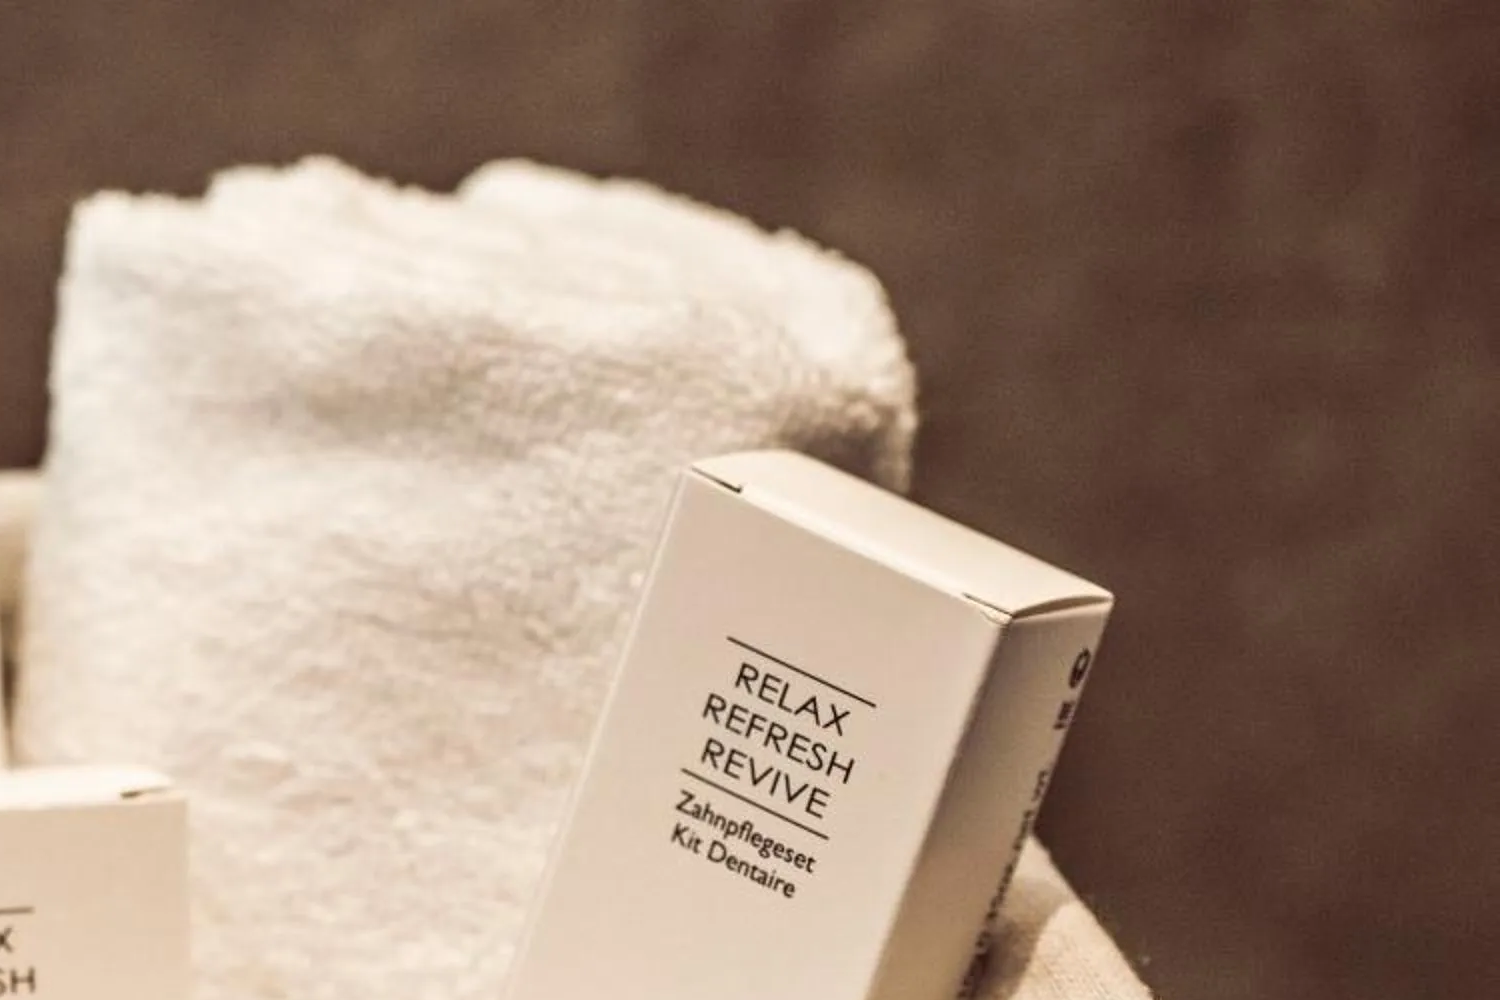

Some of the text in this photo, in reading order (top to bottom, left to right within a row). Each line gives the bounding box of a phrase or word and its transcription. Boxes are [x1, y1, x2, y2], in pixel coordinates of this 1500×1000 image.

[702, 693, 855, 784] REFRESH
[735, 662, 851, 737] RELAX
[701, 737, 831, 820] REVIVE
[671, 822, 796, 899] Kit Dentaire
[675, 789, 816, 874] Zahnpflegeset
